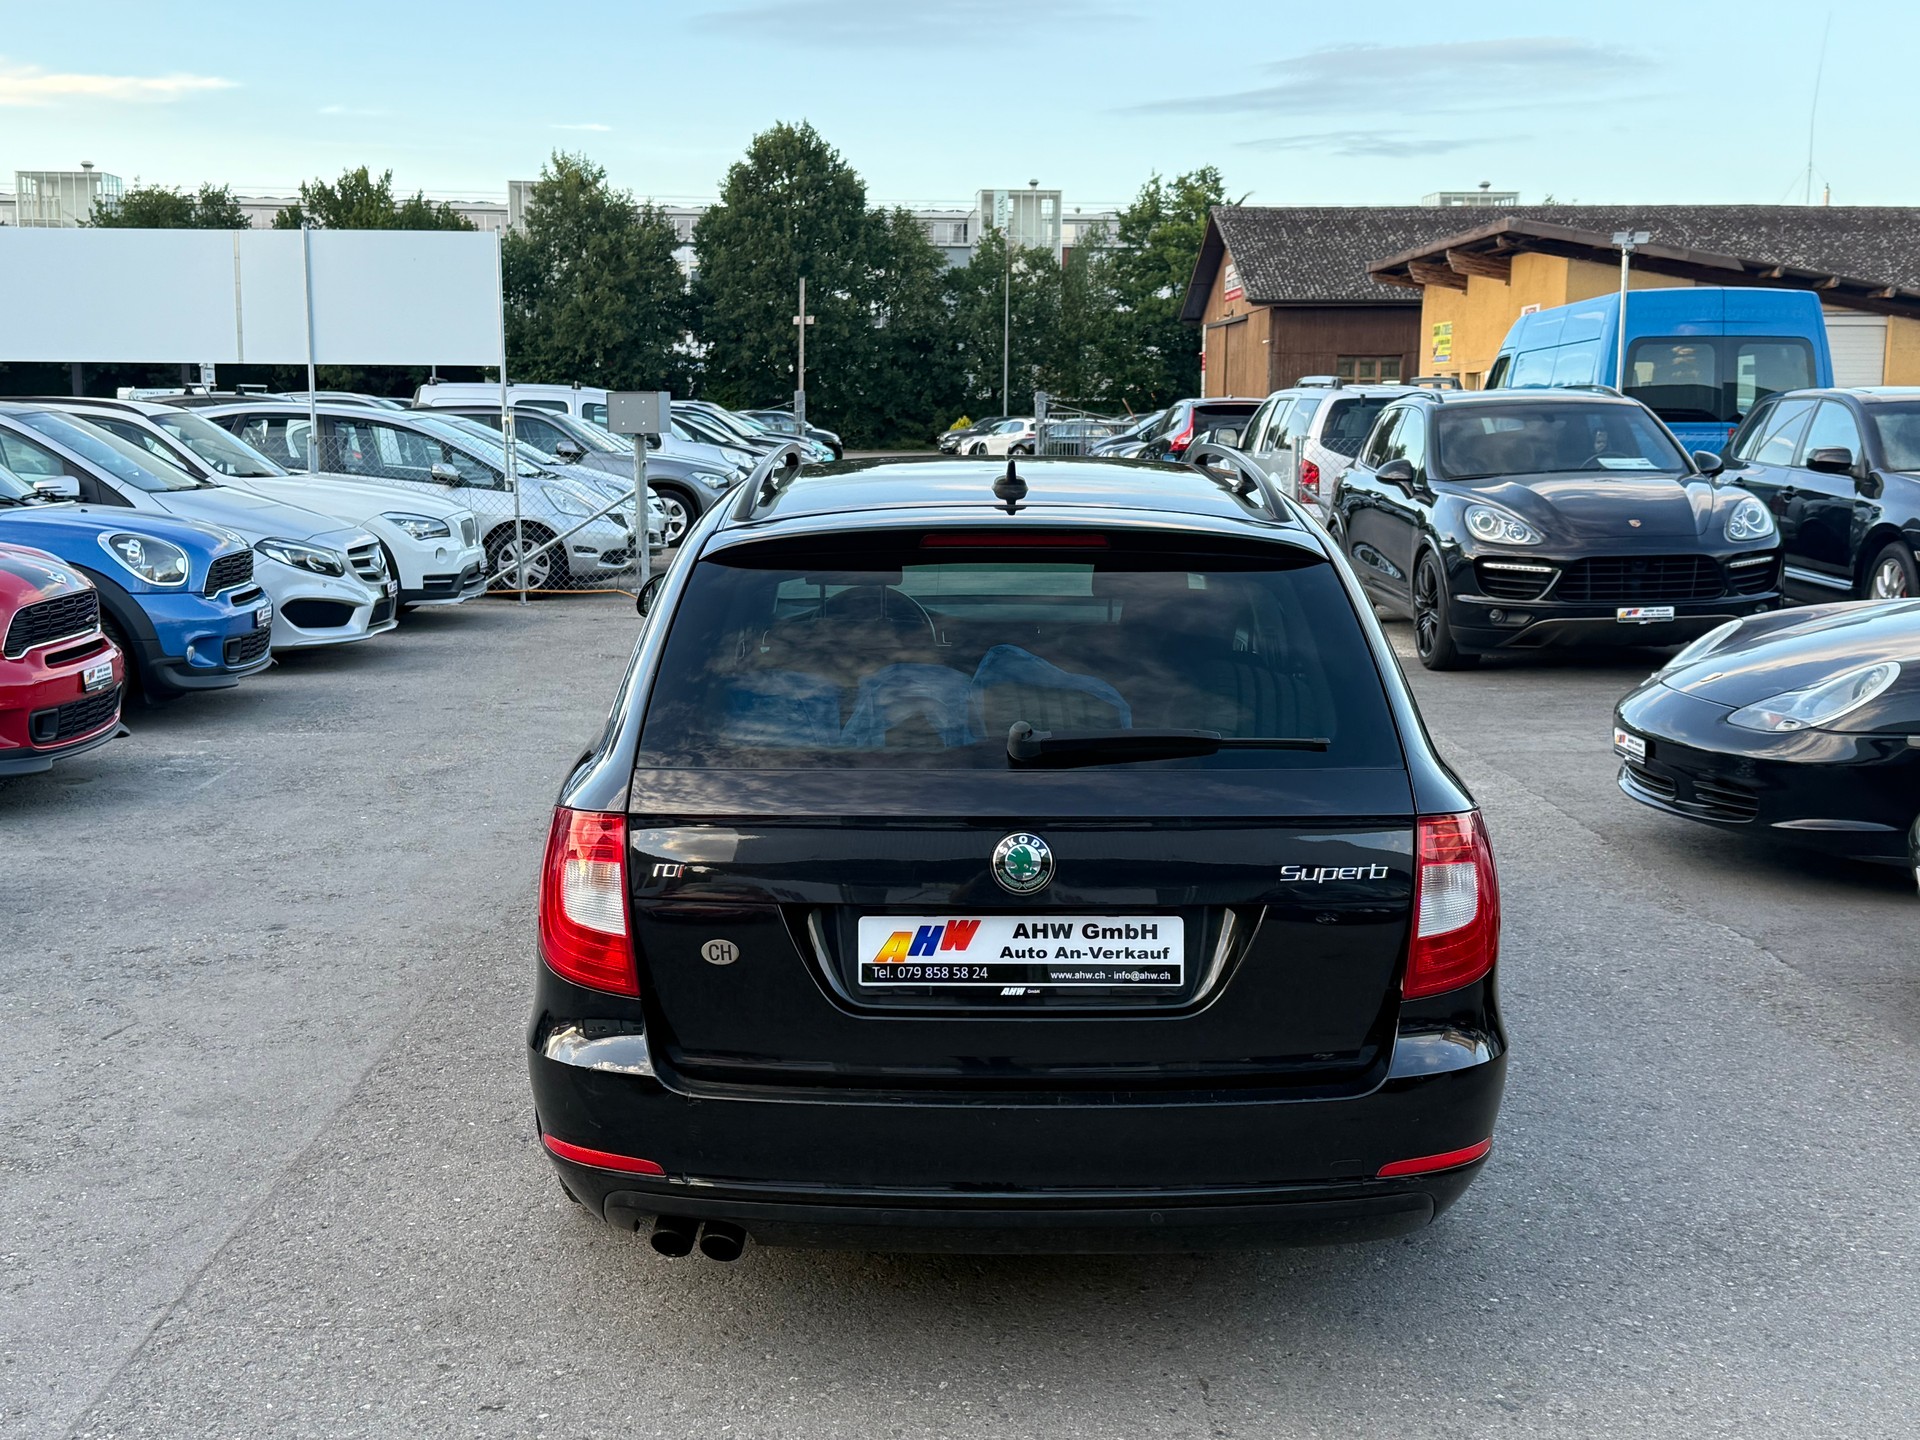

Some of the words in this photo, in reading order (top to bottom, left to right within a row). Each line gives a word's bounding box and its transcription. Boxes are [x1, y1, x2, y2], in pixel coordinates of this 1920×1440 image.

[1280, 863, 1389, 883] Superb
[1012, 923, 1073, 939] AHW
[1082, 923, 1158, 940] GmbH
[873, 919, 981, 962] AHW
[708, 944, 732, 961] CH
[1000, 946, 1048, 959] Auto
[1054, 946, 1170, 960] An-Verkauf
[872, 966, 894, 979] Tel.
[897, 966, 922, 979] 079
[925, 966, 949, 979] 858
[952, 966, 969, 979] 58
[972, 966, 988, 979] 24
[1050, 971, 1106, 980] www.ahw.ch
[1113, 971, 1171, 981] info@ahw.ch
[1000, 987, 1026, 996] AHW
